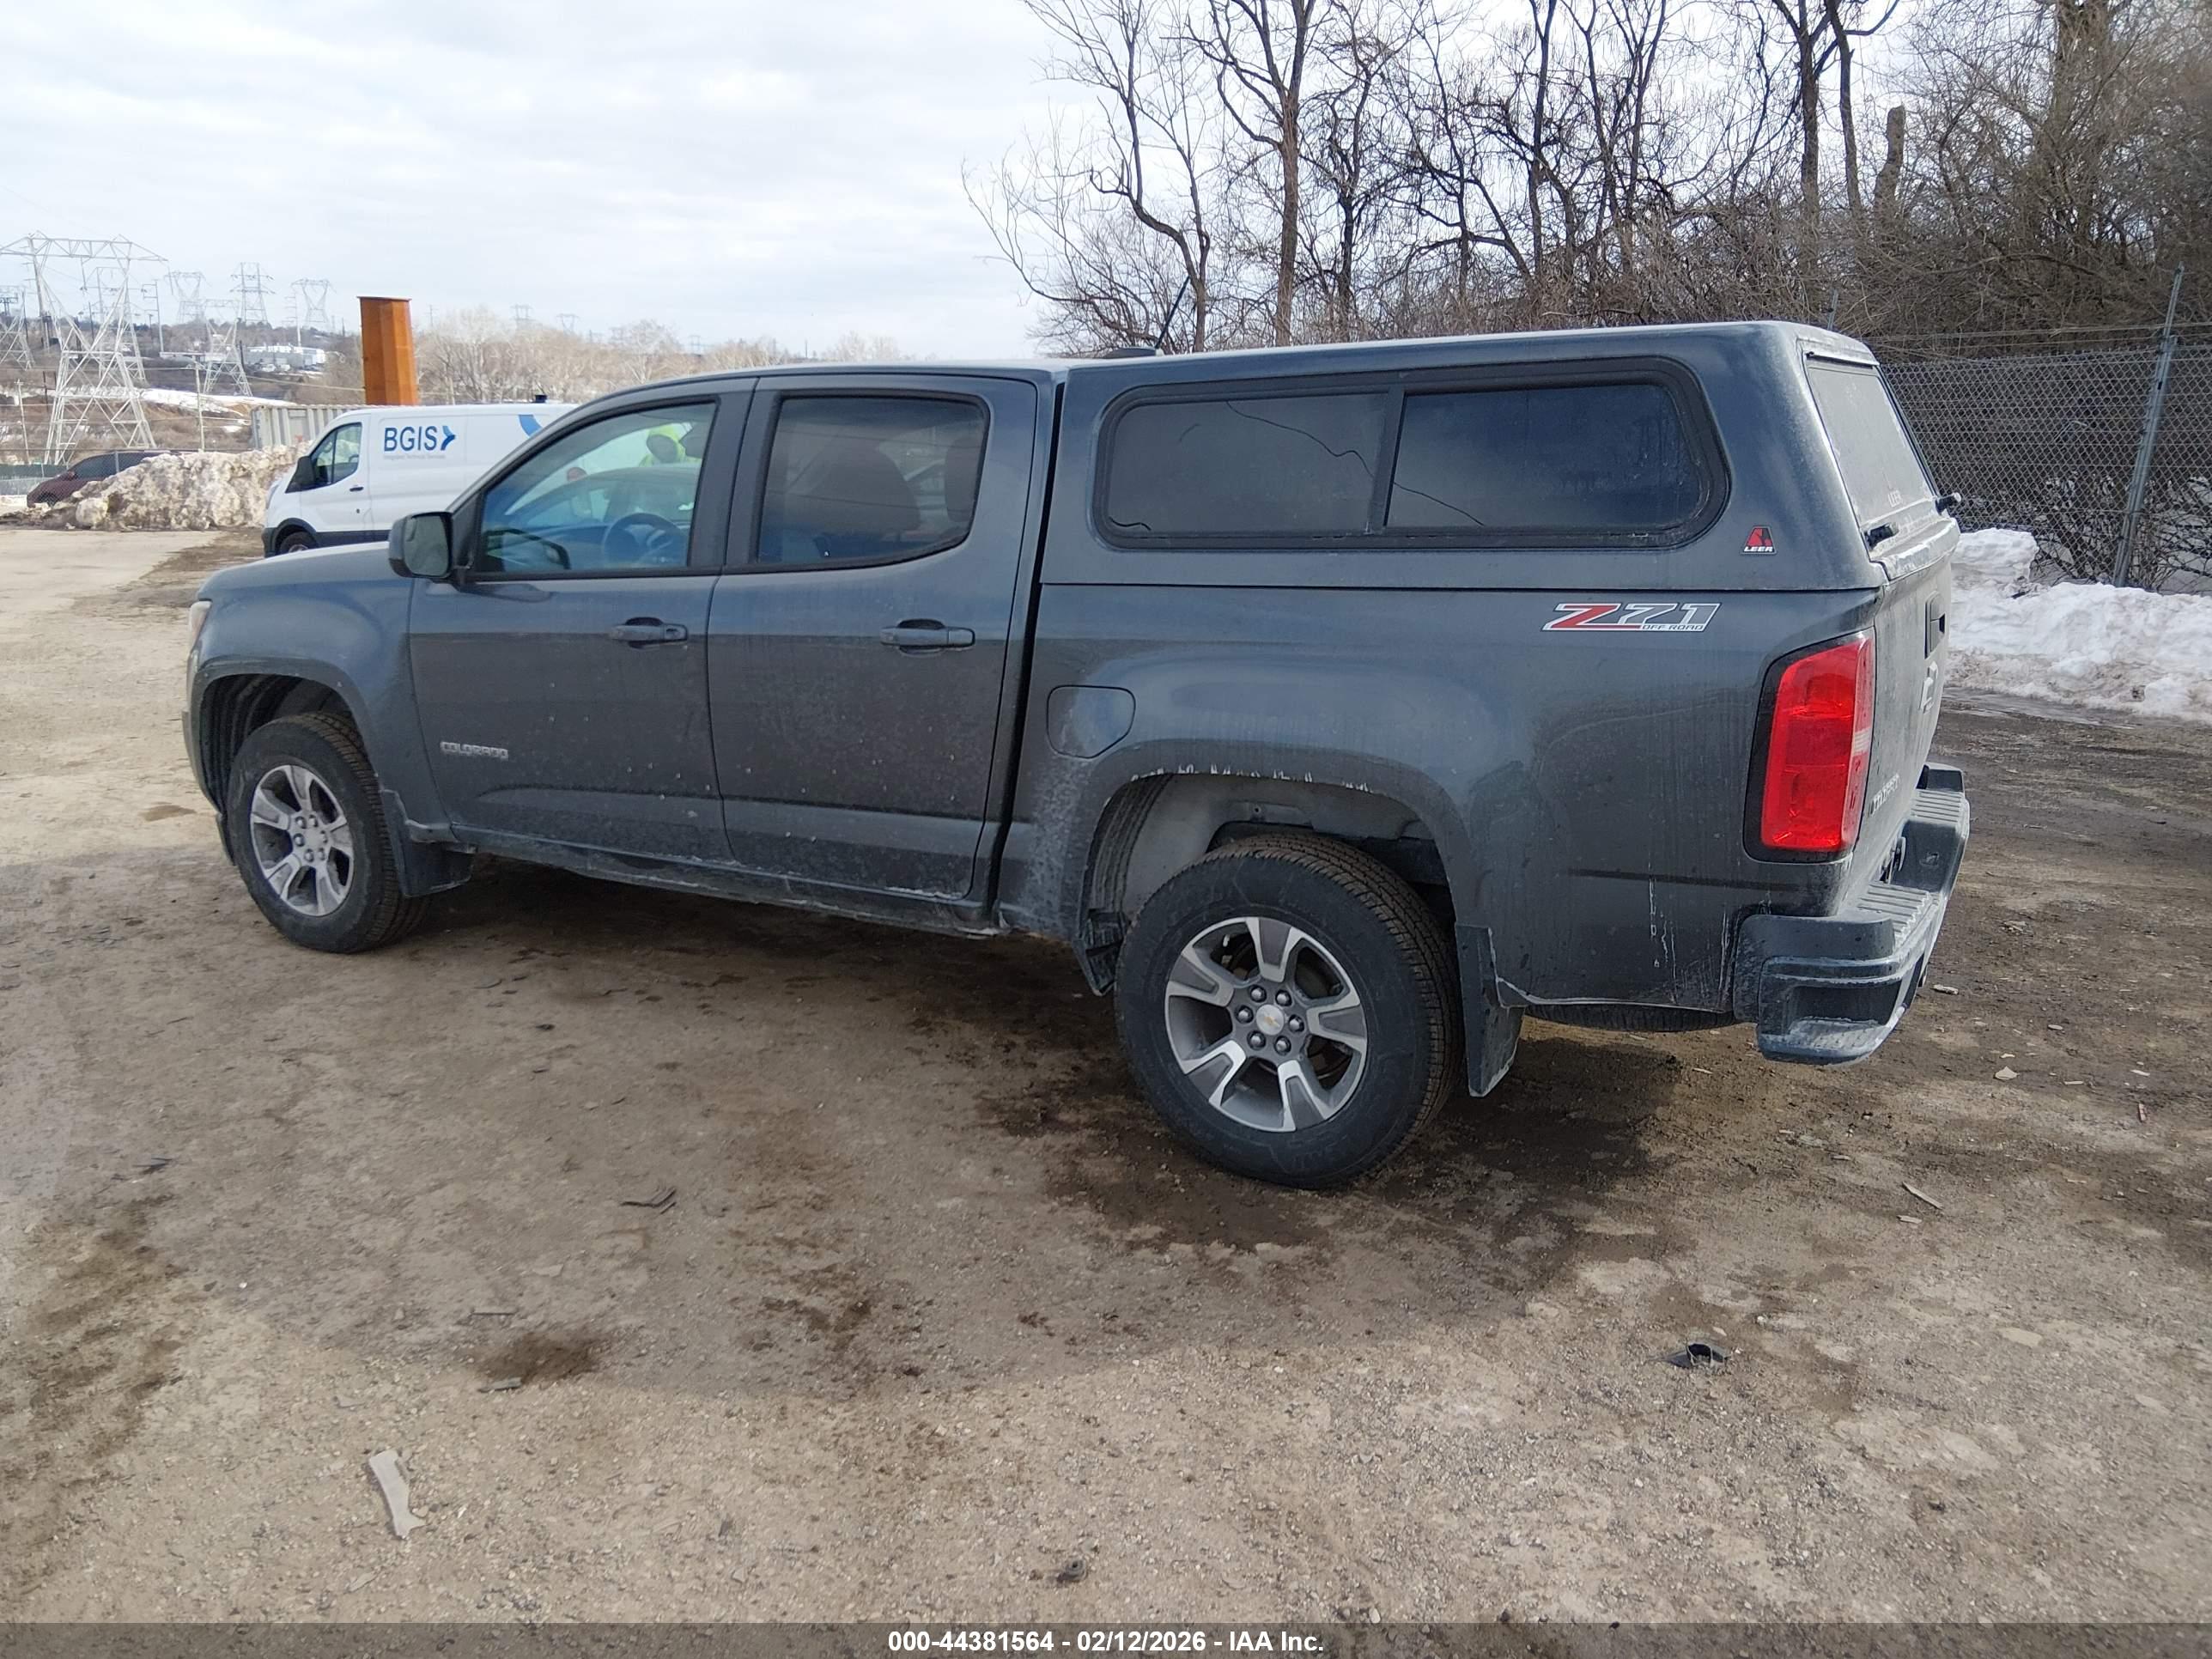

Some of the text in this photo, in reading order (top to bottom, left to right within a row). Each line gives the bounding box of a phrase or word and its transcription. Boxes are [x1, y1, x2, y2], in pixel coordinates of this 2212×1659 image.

[384, 425, 438, 452] BGIS
[1541, 602, 1722, 631] Z71
[439, 741, 509, 761] COLORADO
